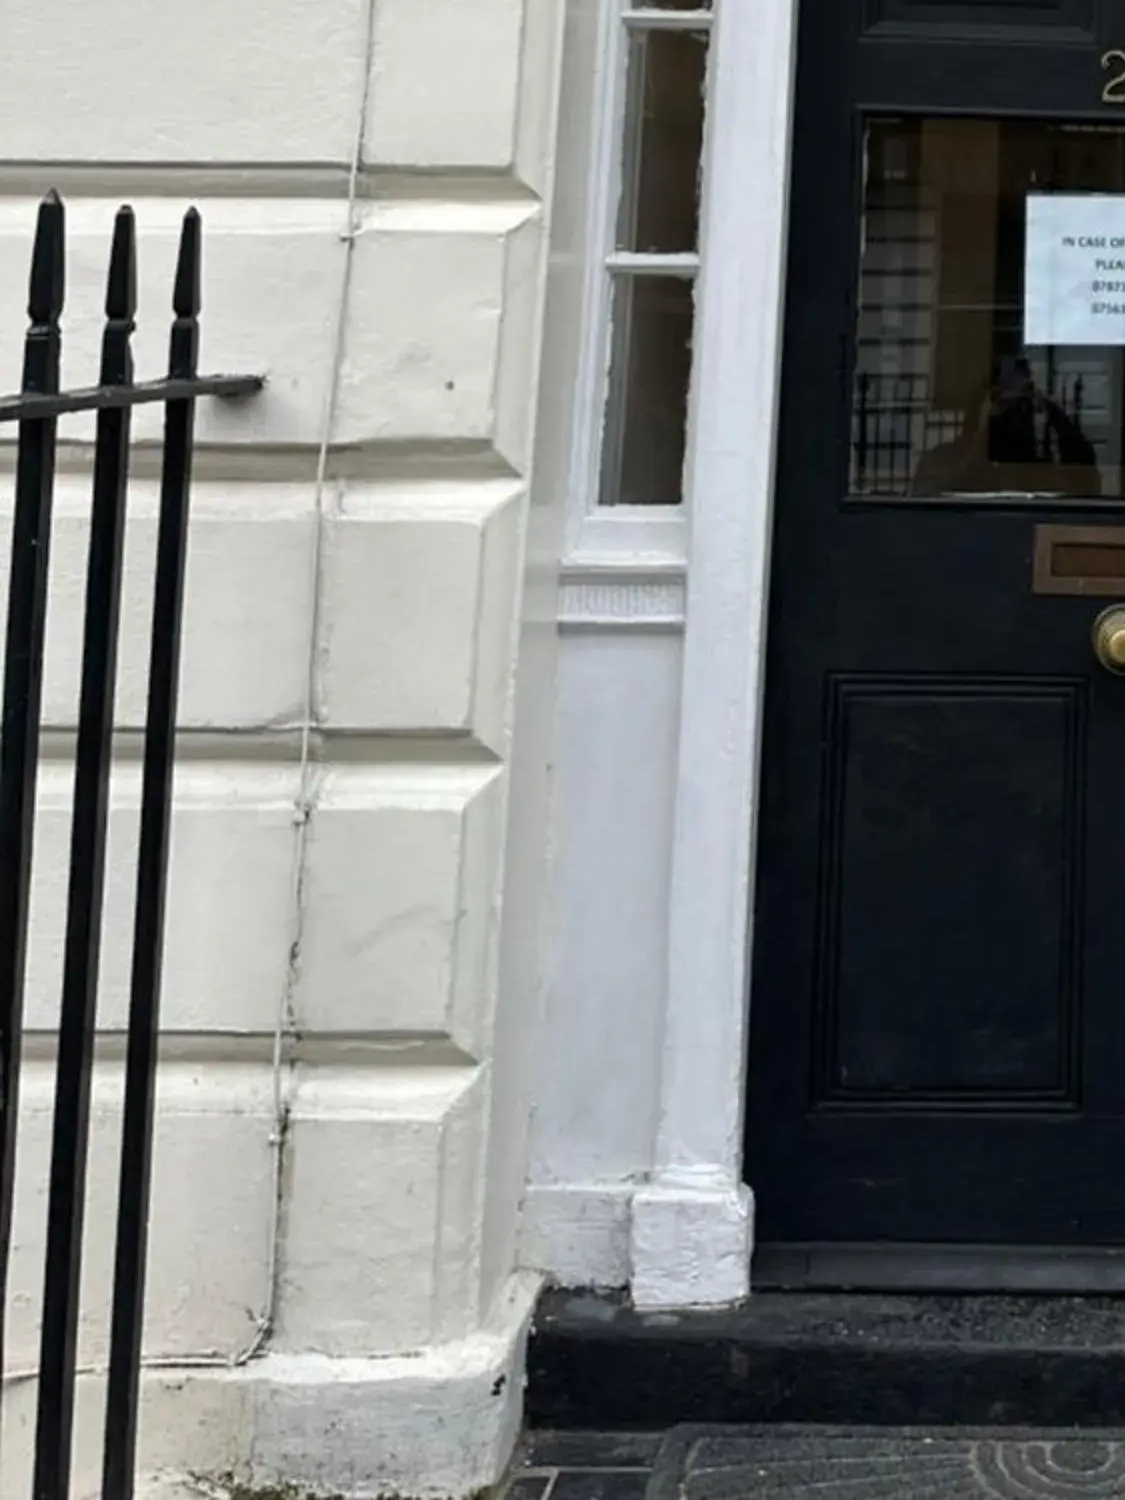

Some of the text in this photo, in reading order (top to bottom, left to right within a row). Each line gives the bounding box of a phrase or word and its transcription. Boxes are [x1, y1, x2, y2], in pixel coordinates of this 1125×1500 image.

[1061, 236, 1075, 247] IN
[1078, 236, 1106, 248] CASE
[1109, 237, 1125, 248] OF
